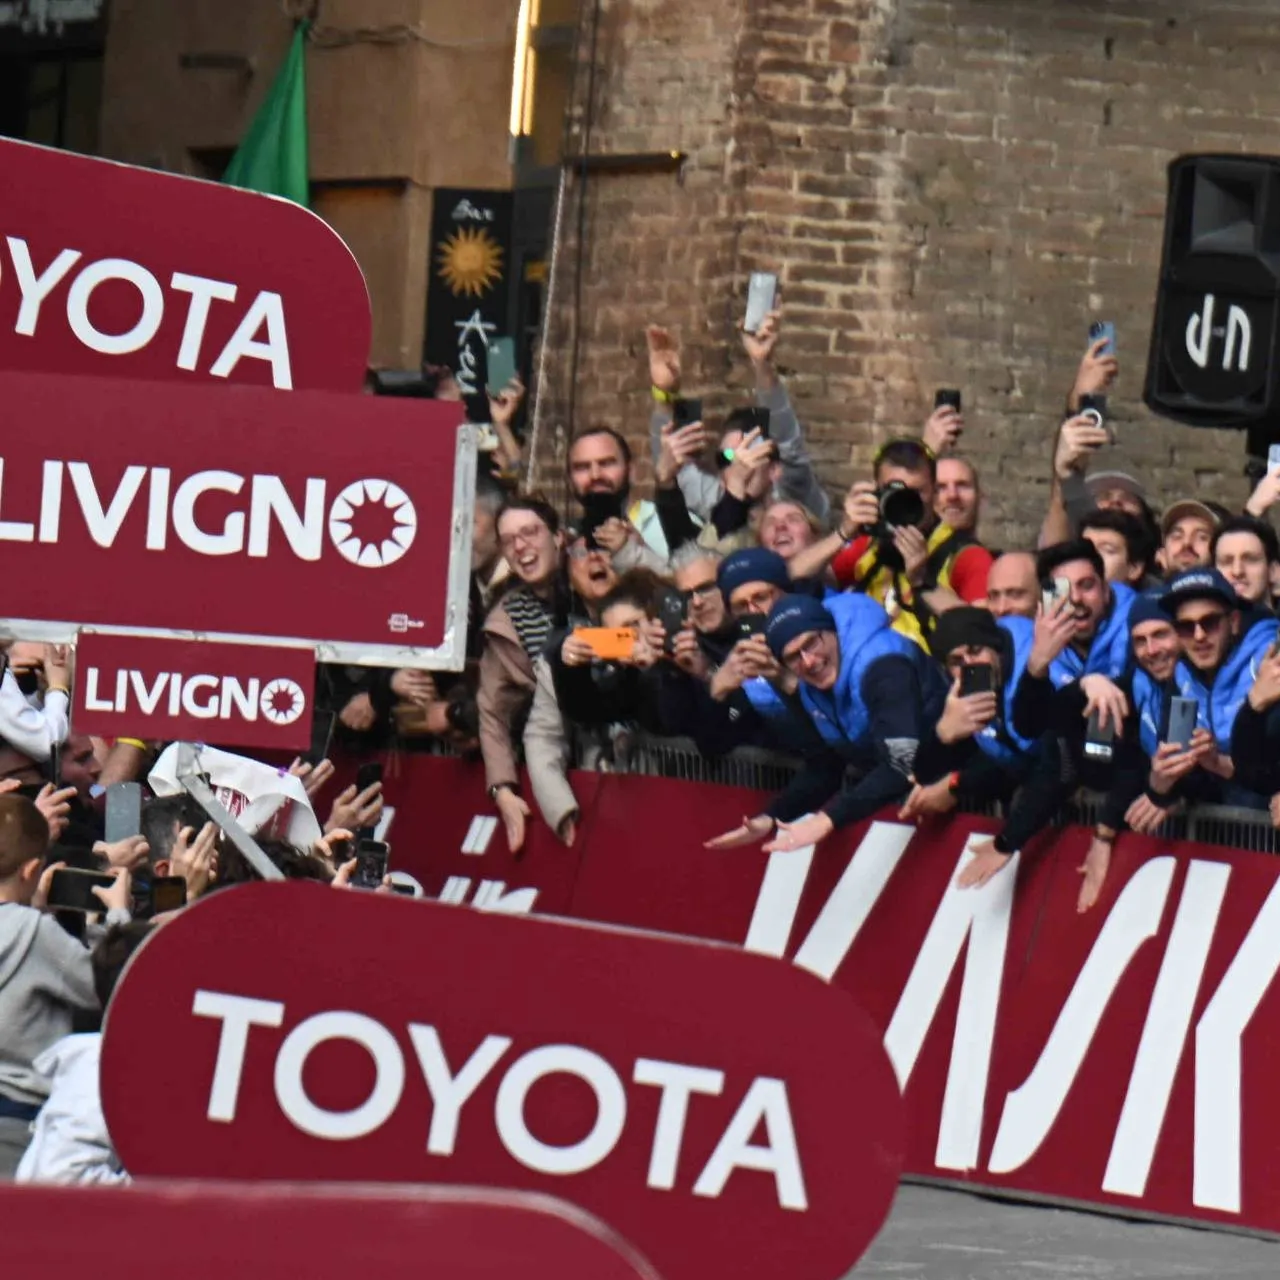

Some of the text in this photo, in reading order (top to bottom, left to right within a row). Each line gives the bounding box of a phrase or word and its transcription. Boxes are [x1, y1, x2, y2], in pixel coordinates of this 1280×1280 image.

[0, 236, 294, 391] YOTA
[0, 456, 418, 569] LIVIGNO
[85, 666, 305, 726] LIVIGNO
[192, 989, 809, 1212] TOYOTA
